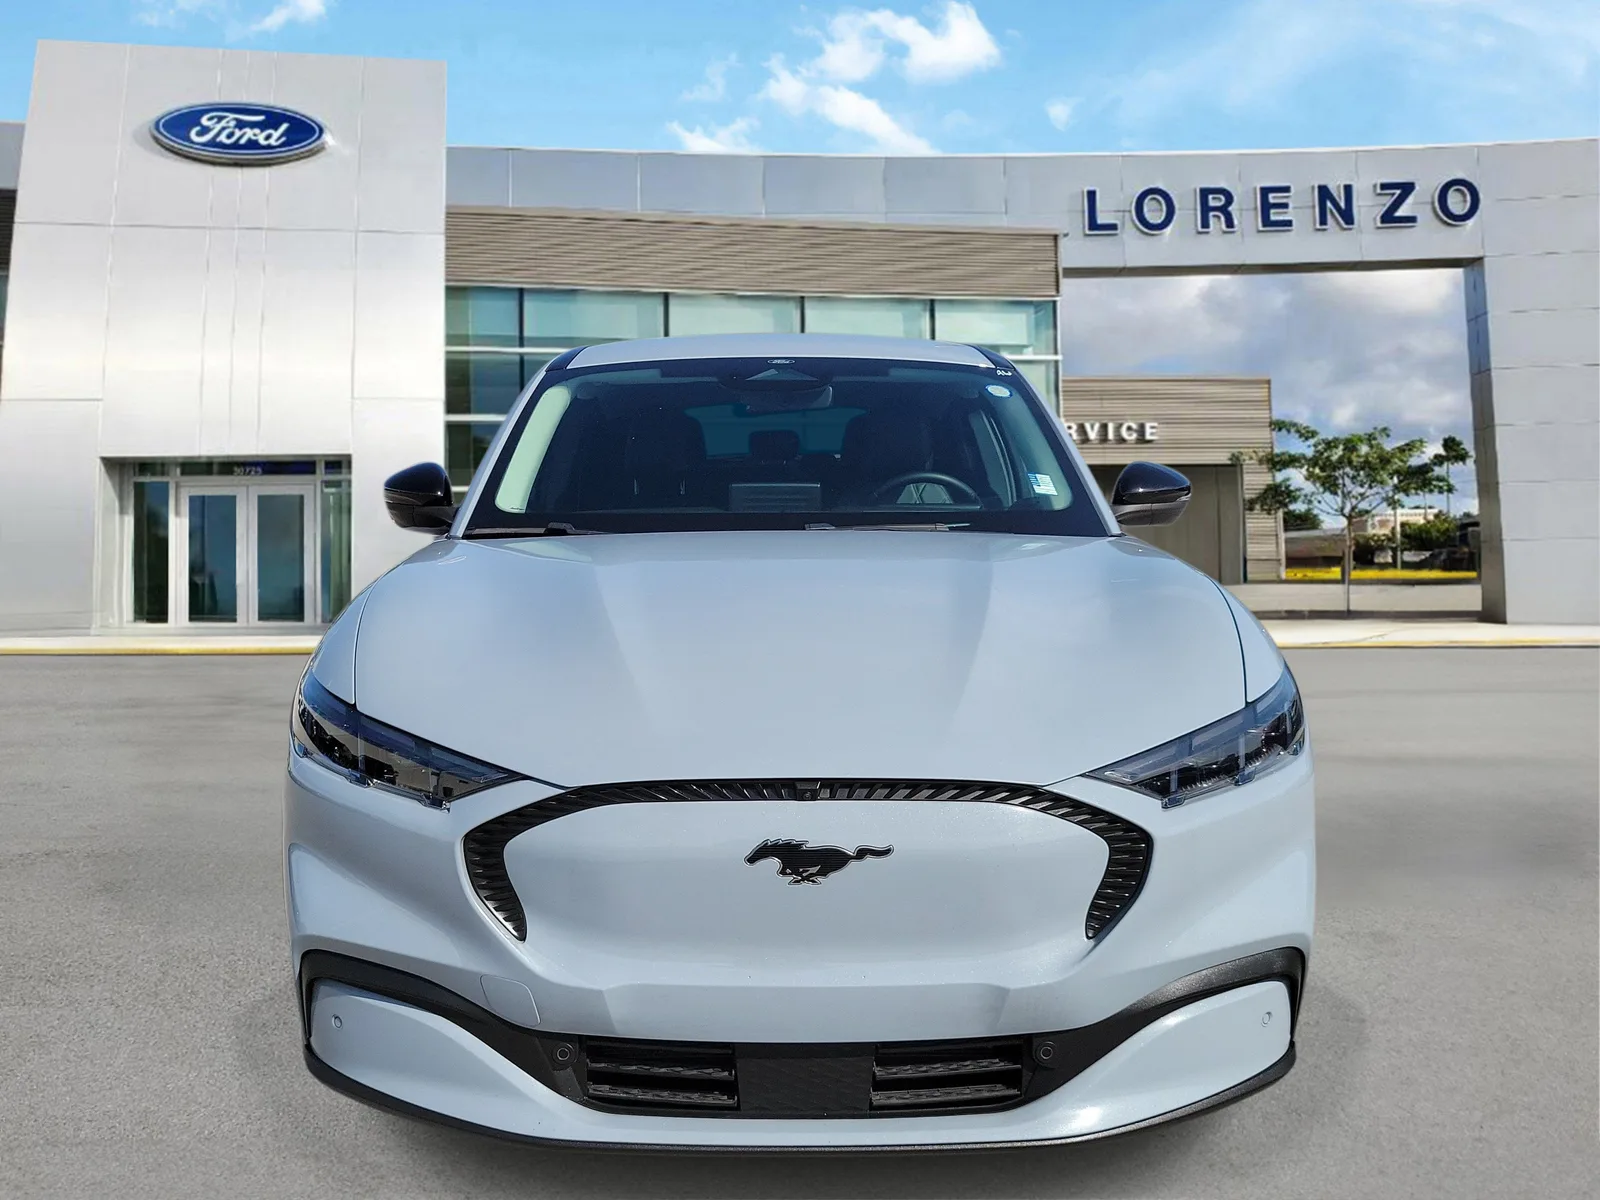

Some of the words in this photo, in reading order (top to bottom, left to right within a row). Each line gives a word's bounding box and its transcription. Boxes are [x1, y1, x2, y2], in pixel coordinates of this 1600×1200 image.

[189, 111, 290, 147] Ford
[1084, 178, 1481, 236] LORENZO
[1065, 422, 1159, 440] RVICE
